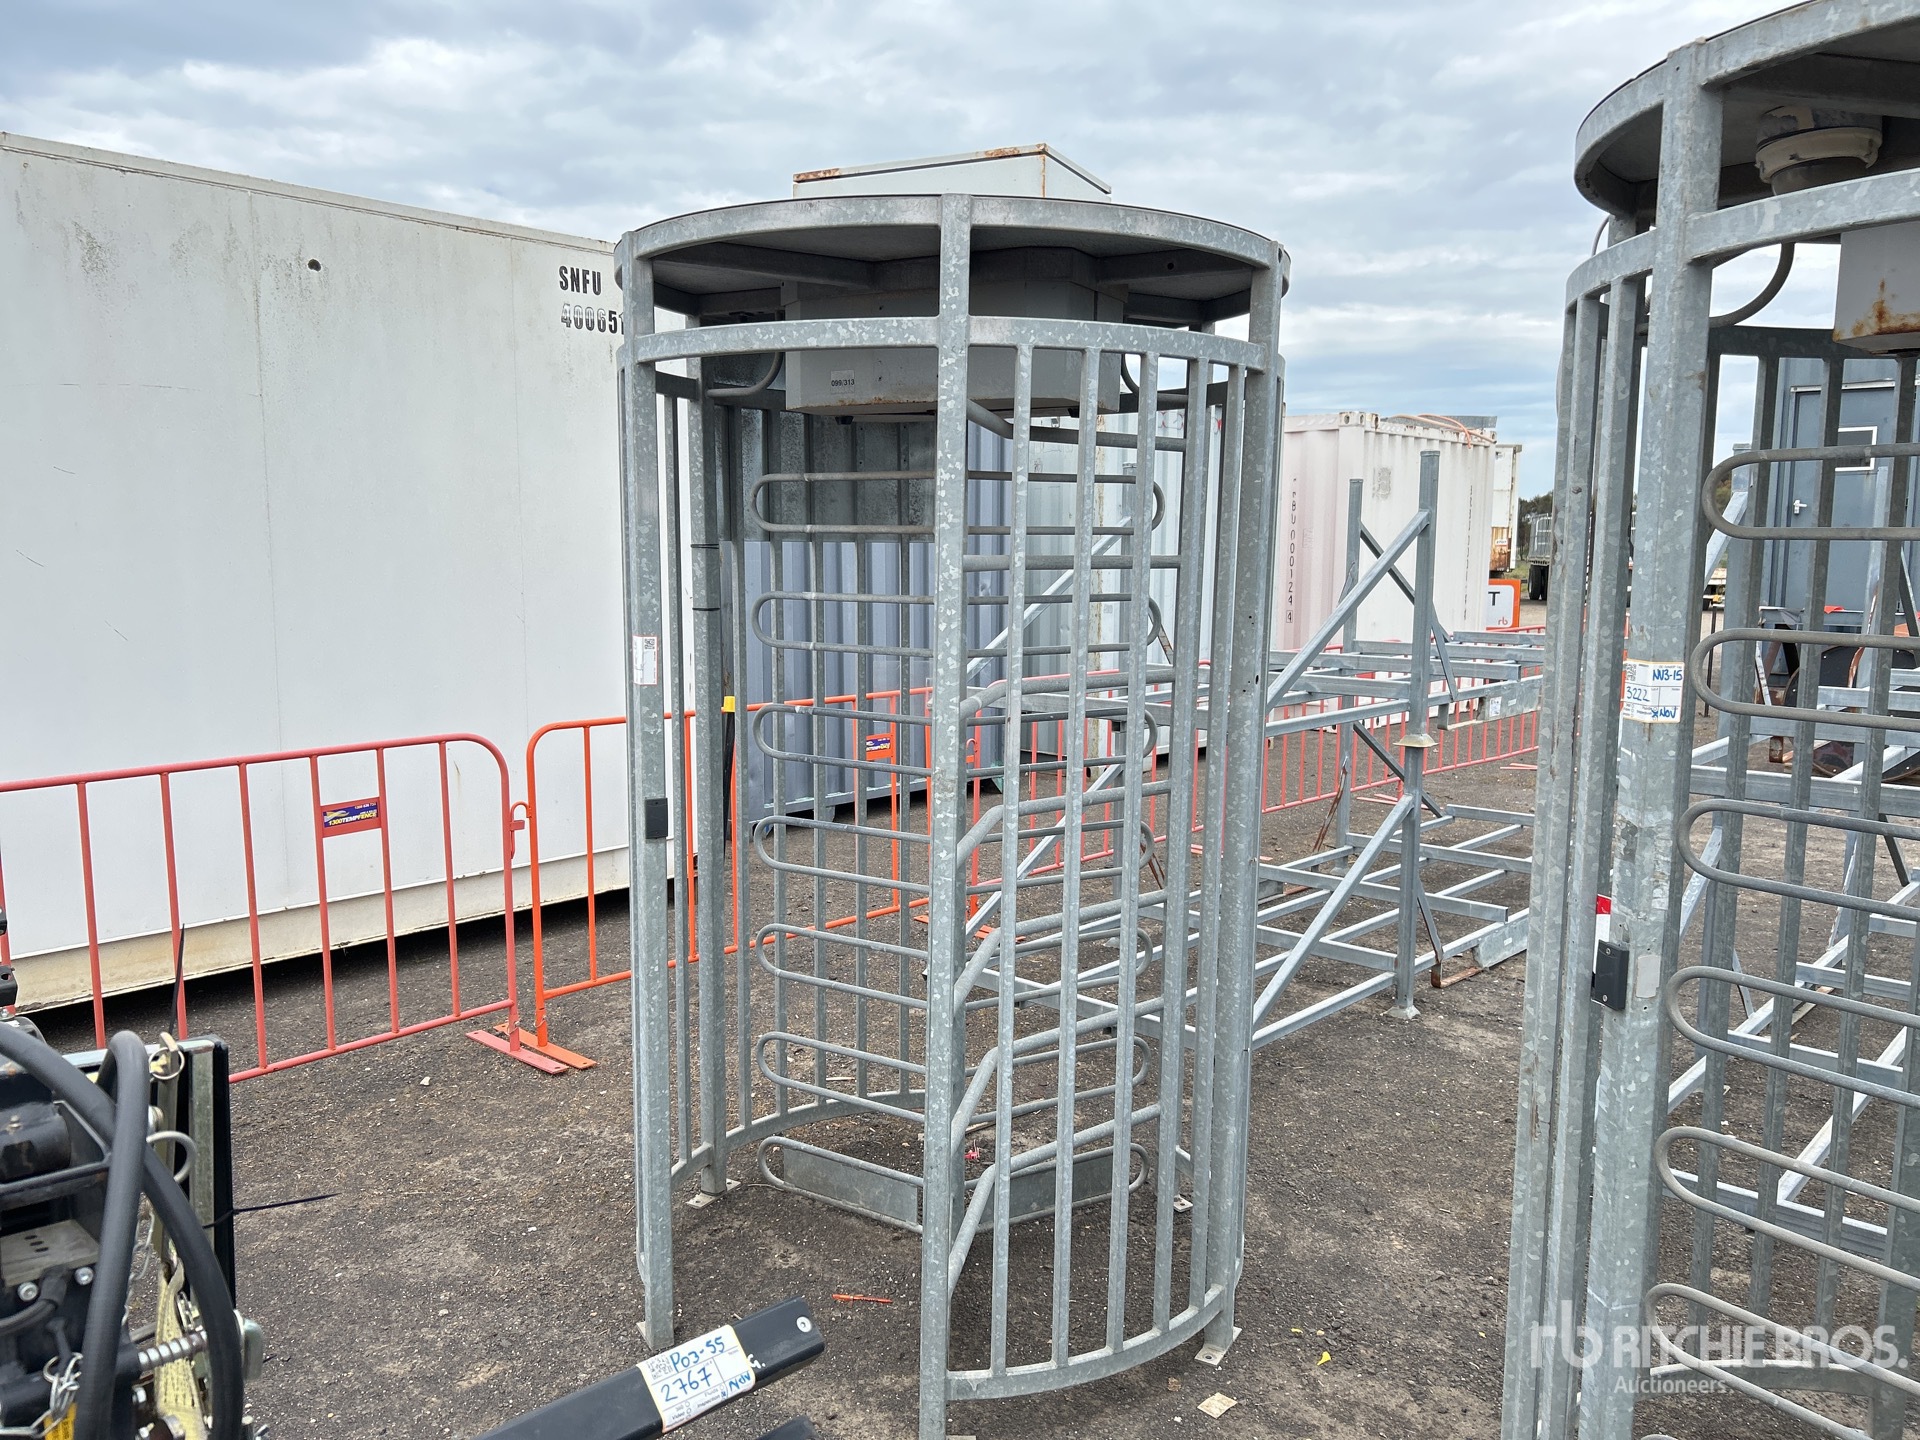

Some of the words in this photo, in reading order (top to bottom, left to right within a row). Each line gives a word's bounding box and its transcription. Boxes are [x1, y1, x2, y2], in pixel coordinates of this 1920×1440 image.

[559, 266, 602, 296] SNFU
[1488, 591, 1500, 606] T
[660, 1366, 713, 1402] 2767
